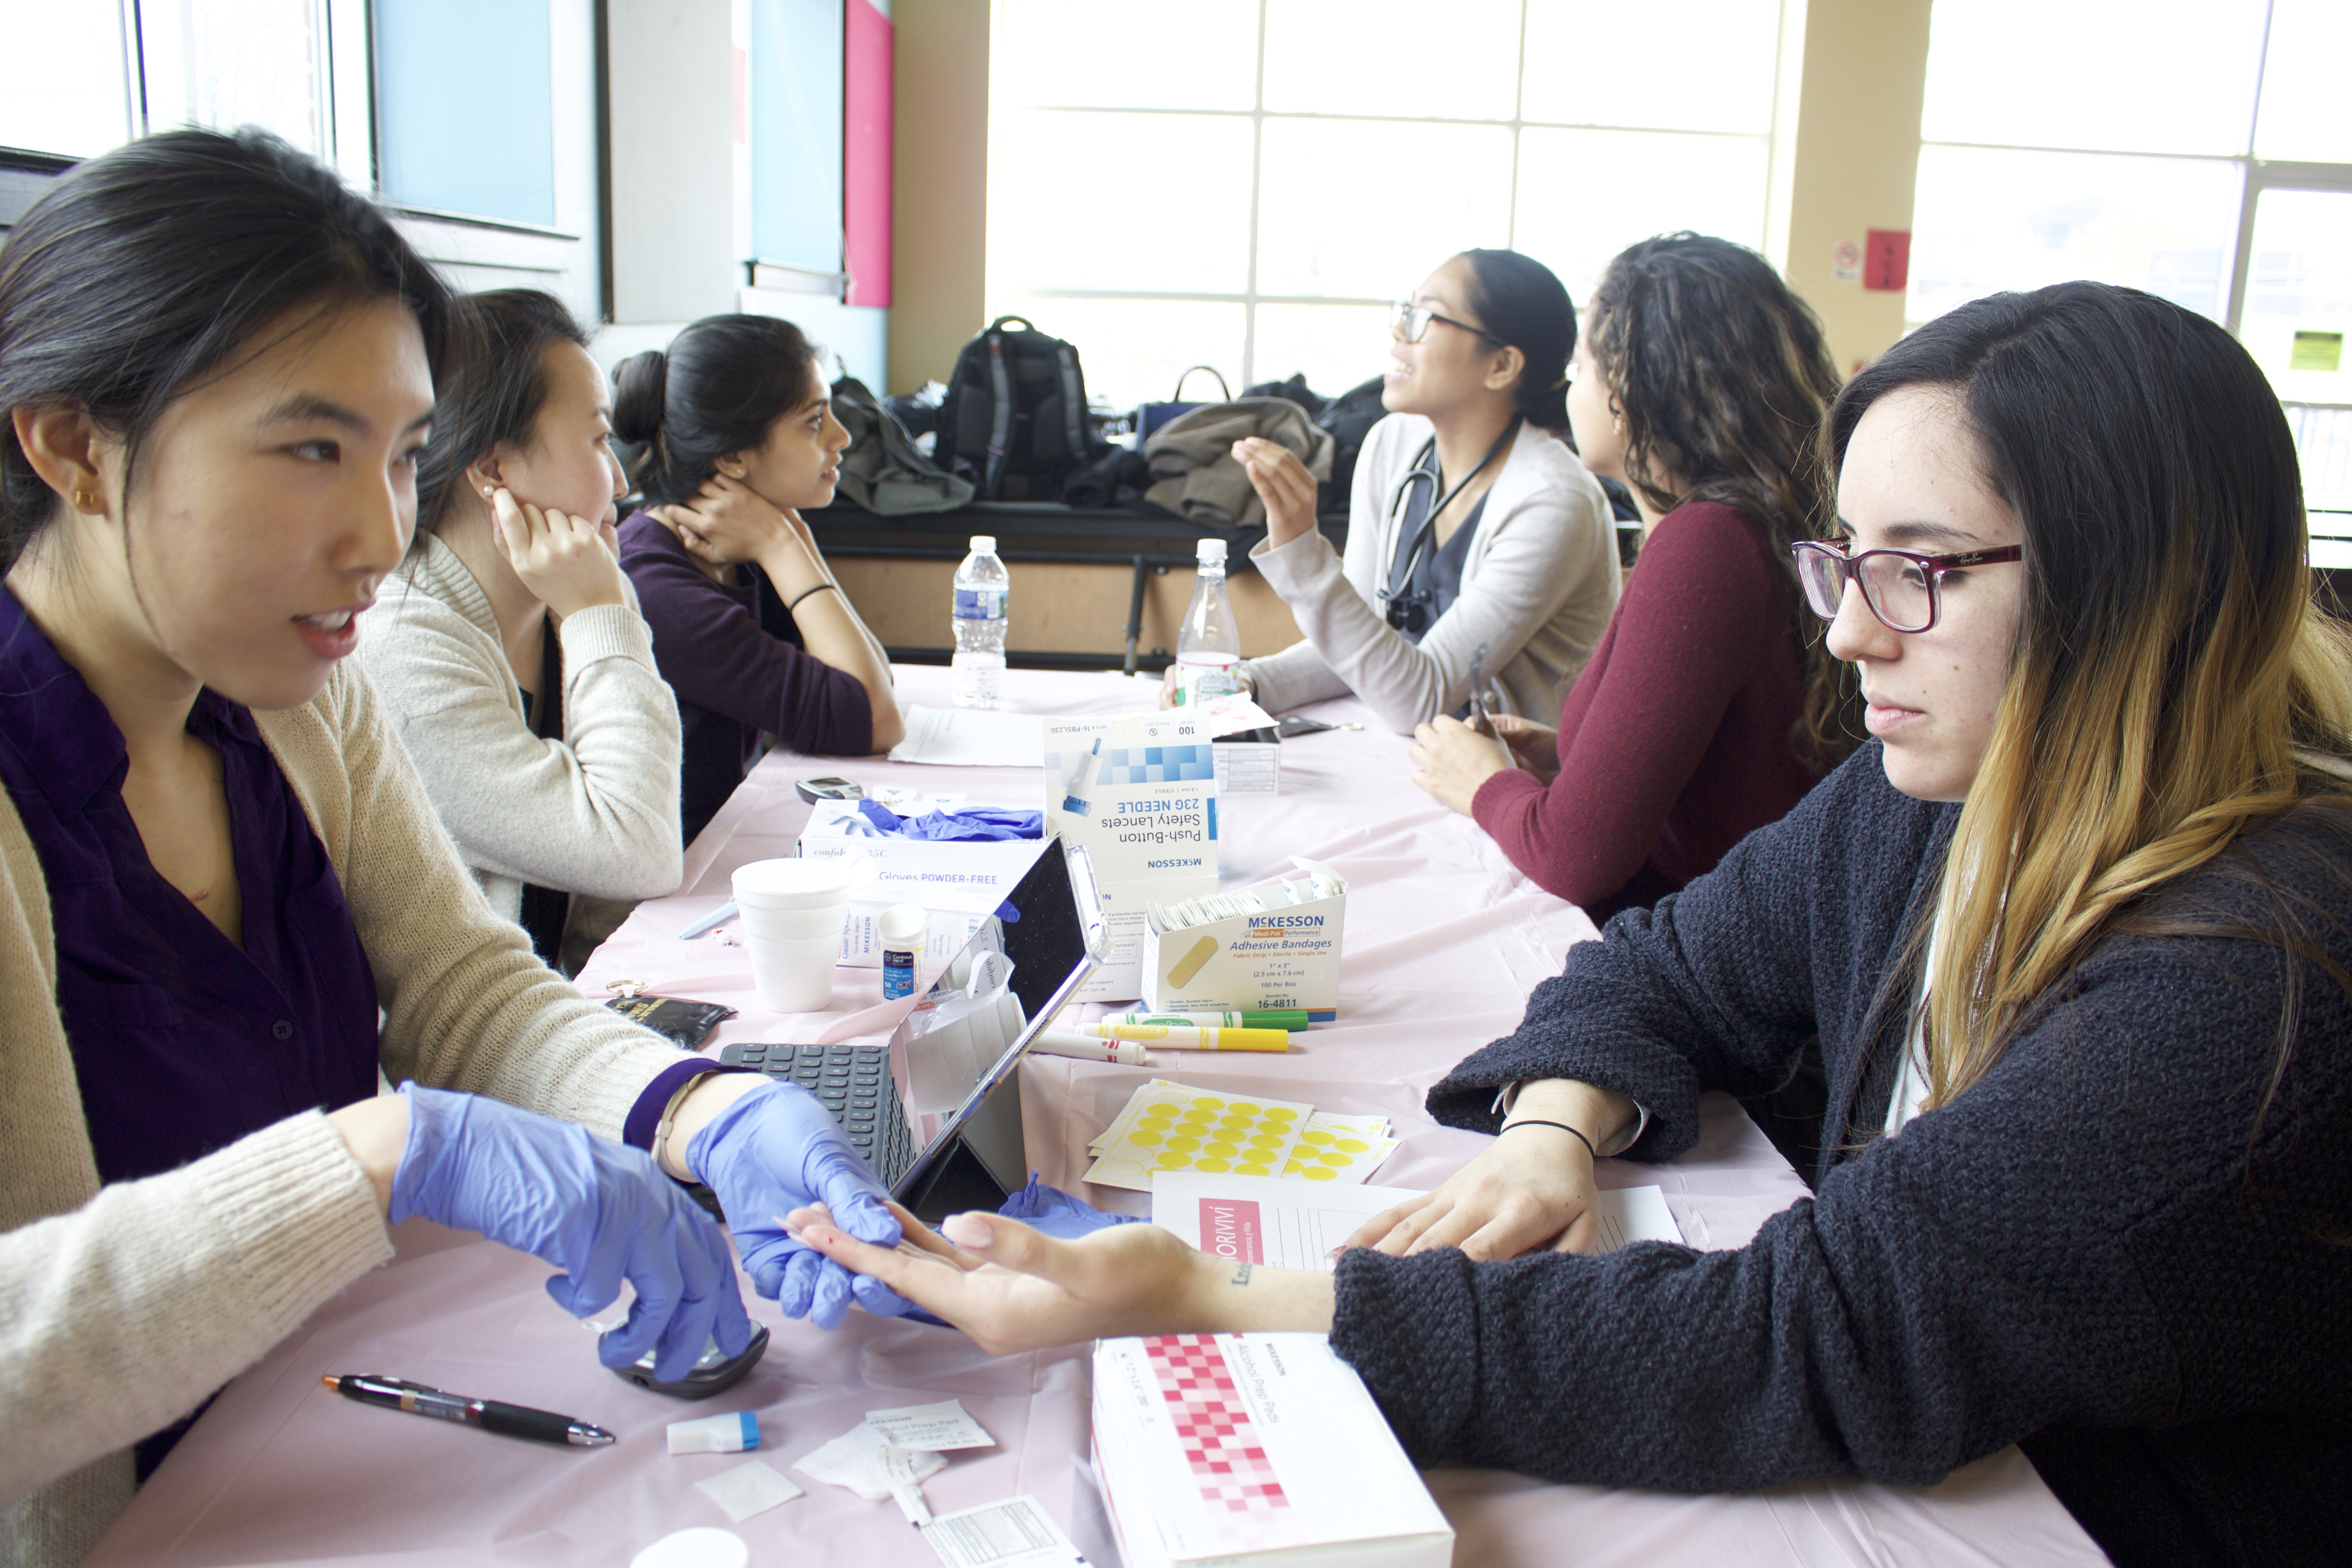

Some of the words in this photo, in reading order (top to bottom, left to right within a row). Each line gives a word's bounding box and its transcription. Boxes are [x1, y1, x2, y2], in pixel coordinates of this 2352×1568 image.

[1117, 800, 1171, 813] NEEDLE
[1175, 798, 1199, 811] 23G
[1102, 817, 1153, 828] Lancets
[1158, 813, 1200, 826] Safety
[1119, 830, 1201, 843] Push-Button
[814, 848, 845, 858] confid
[1148, 858, 1201, 868] McKESSON
[879, 872, 918, 881] Gloves
[921, 873, 998, 884] POWDER-FREE
[1249, 916, 1324, 928] McKESSON
[1230, 941, 1279, 951] Adhesive
[1281, 939, 1332, 950] Bandages
[1258, 999, 1297, 1009] 16-4811
[1120, 1025, 1165, 1036] Crayola
[1371, 1148, 1386, 1161] AVERY
[1208, 1206, 1237, 1260] ORIVIVÍ
[1244, 1236, 1254, 1265] erceverancia,
[1265, 1343, 1287, 1377] McKESSON
[1236, 1344, 1259, 1378] Alcohol
[1254, 1378, 1269, 1401] Prep
[1264, 1401, 1280, 1424] Pads
[871, 1417, 911, 1425] cKESSON
